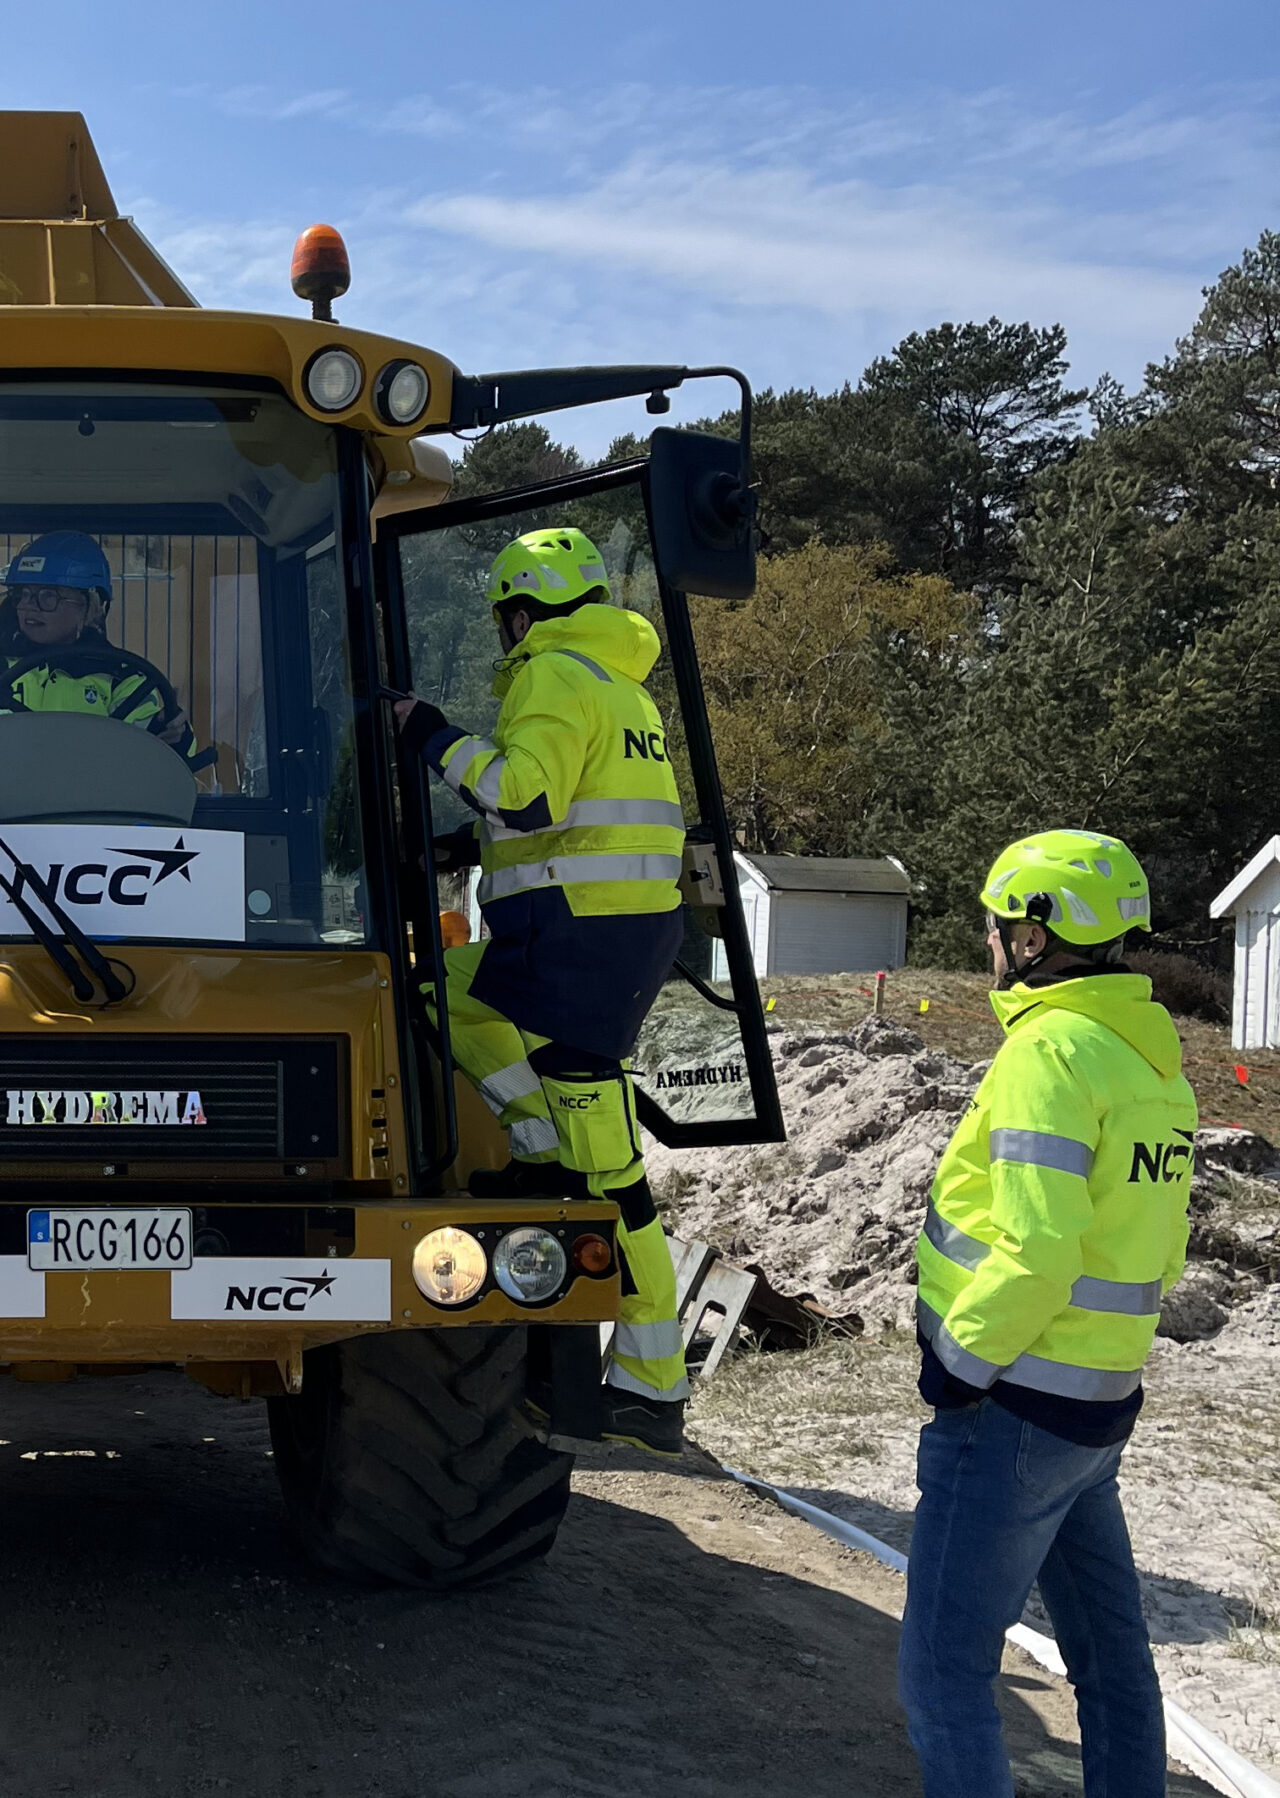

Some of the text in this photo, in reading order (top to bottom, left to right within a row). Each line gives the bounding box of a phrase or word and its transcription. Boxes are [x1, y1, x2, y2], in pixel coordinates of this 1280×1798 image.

[623, 728, 672, 762] NC
[6, 863, 152, 906] NCC
[6, 1090, 208, 1125] HYDREMA
[559, 1095, 589, 1110] NCC
[37, 1231, 44, 1240] S
[224, 1285, 309, 1312] NCC
